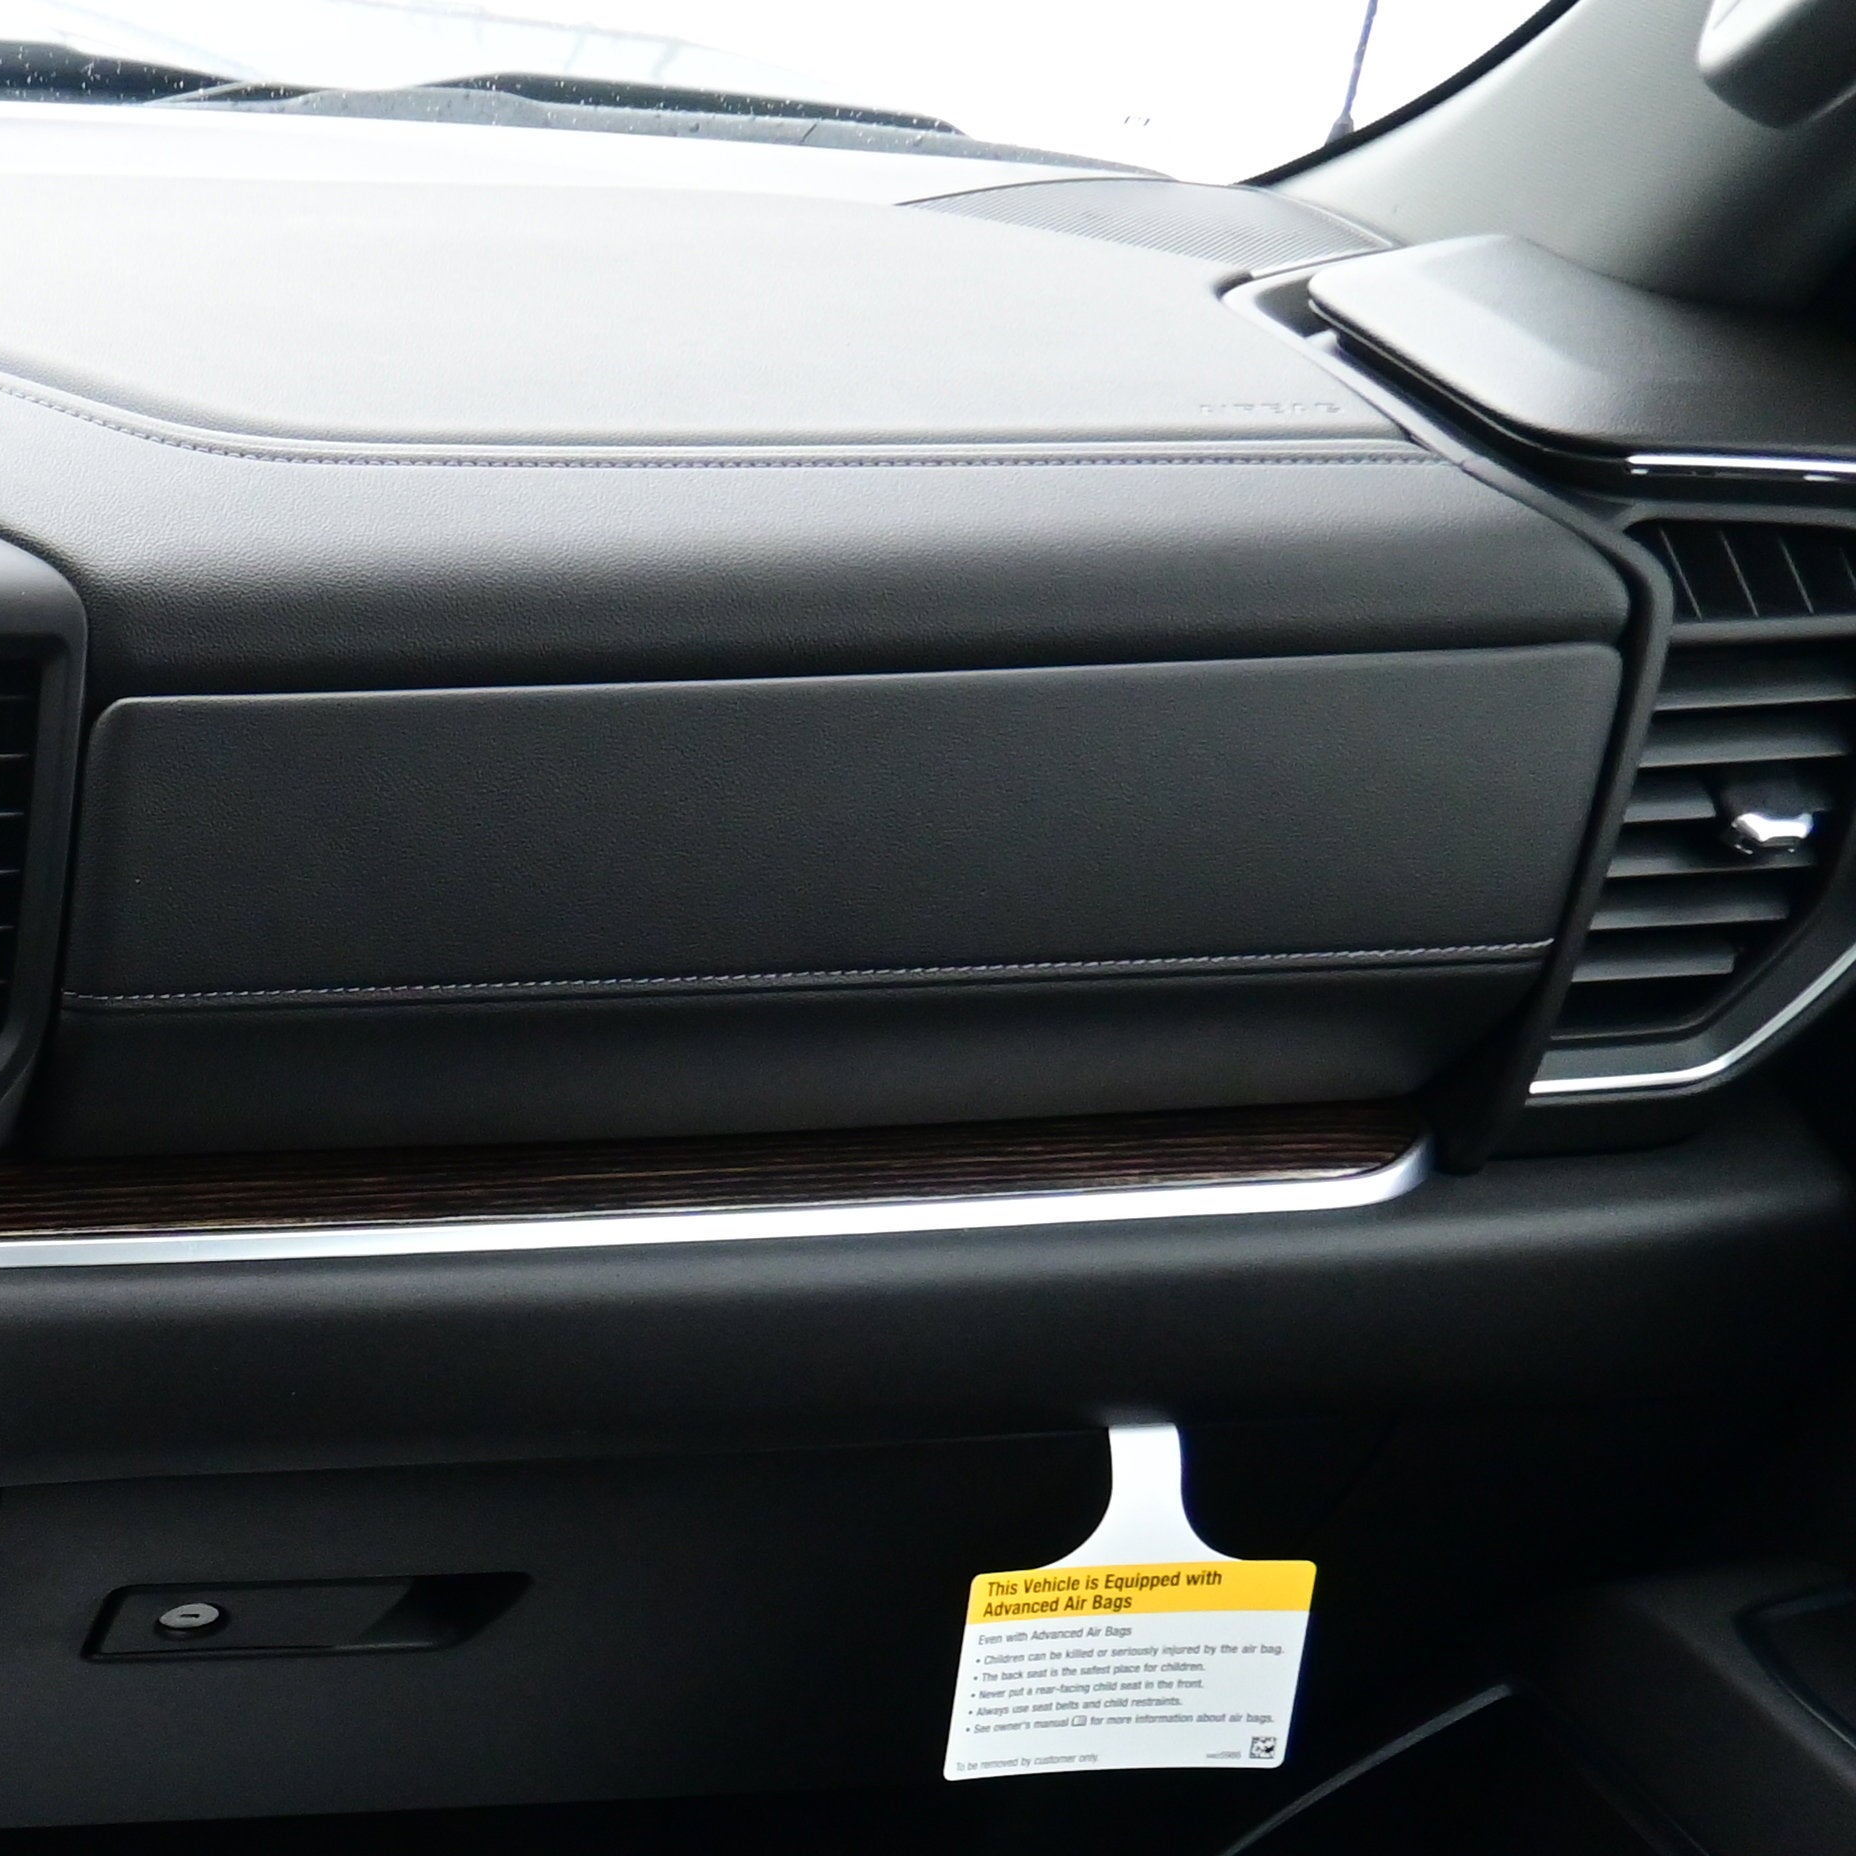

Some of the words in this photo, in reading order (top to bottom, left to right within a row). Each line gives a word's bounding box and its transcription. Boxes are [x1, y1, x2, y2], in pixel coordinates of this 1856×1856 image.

[988, 1581, 1017, 1596] This
[1024, 1577, 1080, 1594] Vehicle
[1085, 1575, 1099, 1590] is
[1105, 1572, 1181, 1591] Equipped
[1186, 1571, 1222, 1585] with
[983, 1597, 1059, 1617] Advanced
[1064, 1596, 1087, 1611] Air
[1092, 1595, 1132, 1612] Bags
[978, 1634, 1002, 1646] Even
[1006, 1632, 1028, 1643] with
[1031, 1628, 1084, 1640] Advanced
[1086, 1627, 1101, 1637] Air
[1105, 1626, 1132, 1638] Bags
[984, 1653, 1025, 1665] Children
[1028, 1652, 1046, 1661] can
[1050, 1650, 1062, 1660] be
[1097, 1648, 1108, 1657] or
[1111, 1646, 1159, 1658] seriously
[1204, 1645, 1217, 1656] by
[1220, 1644, 1238, 1654] the
[1241, 1644, 1257, 1653] air
[1260, 1644, 1284, 1656] bag.
[982, 1673, 998, 1682] The
[1001, 1671, 1023, 1681] back
[1027, 1669, 1047, 1678] seat
[1061, 1667, 1077, 1676] the
[1080, 1665, 1110, 1675] safest
[1113, 1664, 1140, 1676] place
[1144, 1663, 1157, 1672] for
